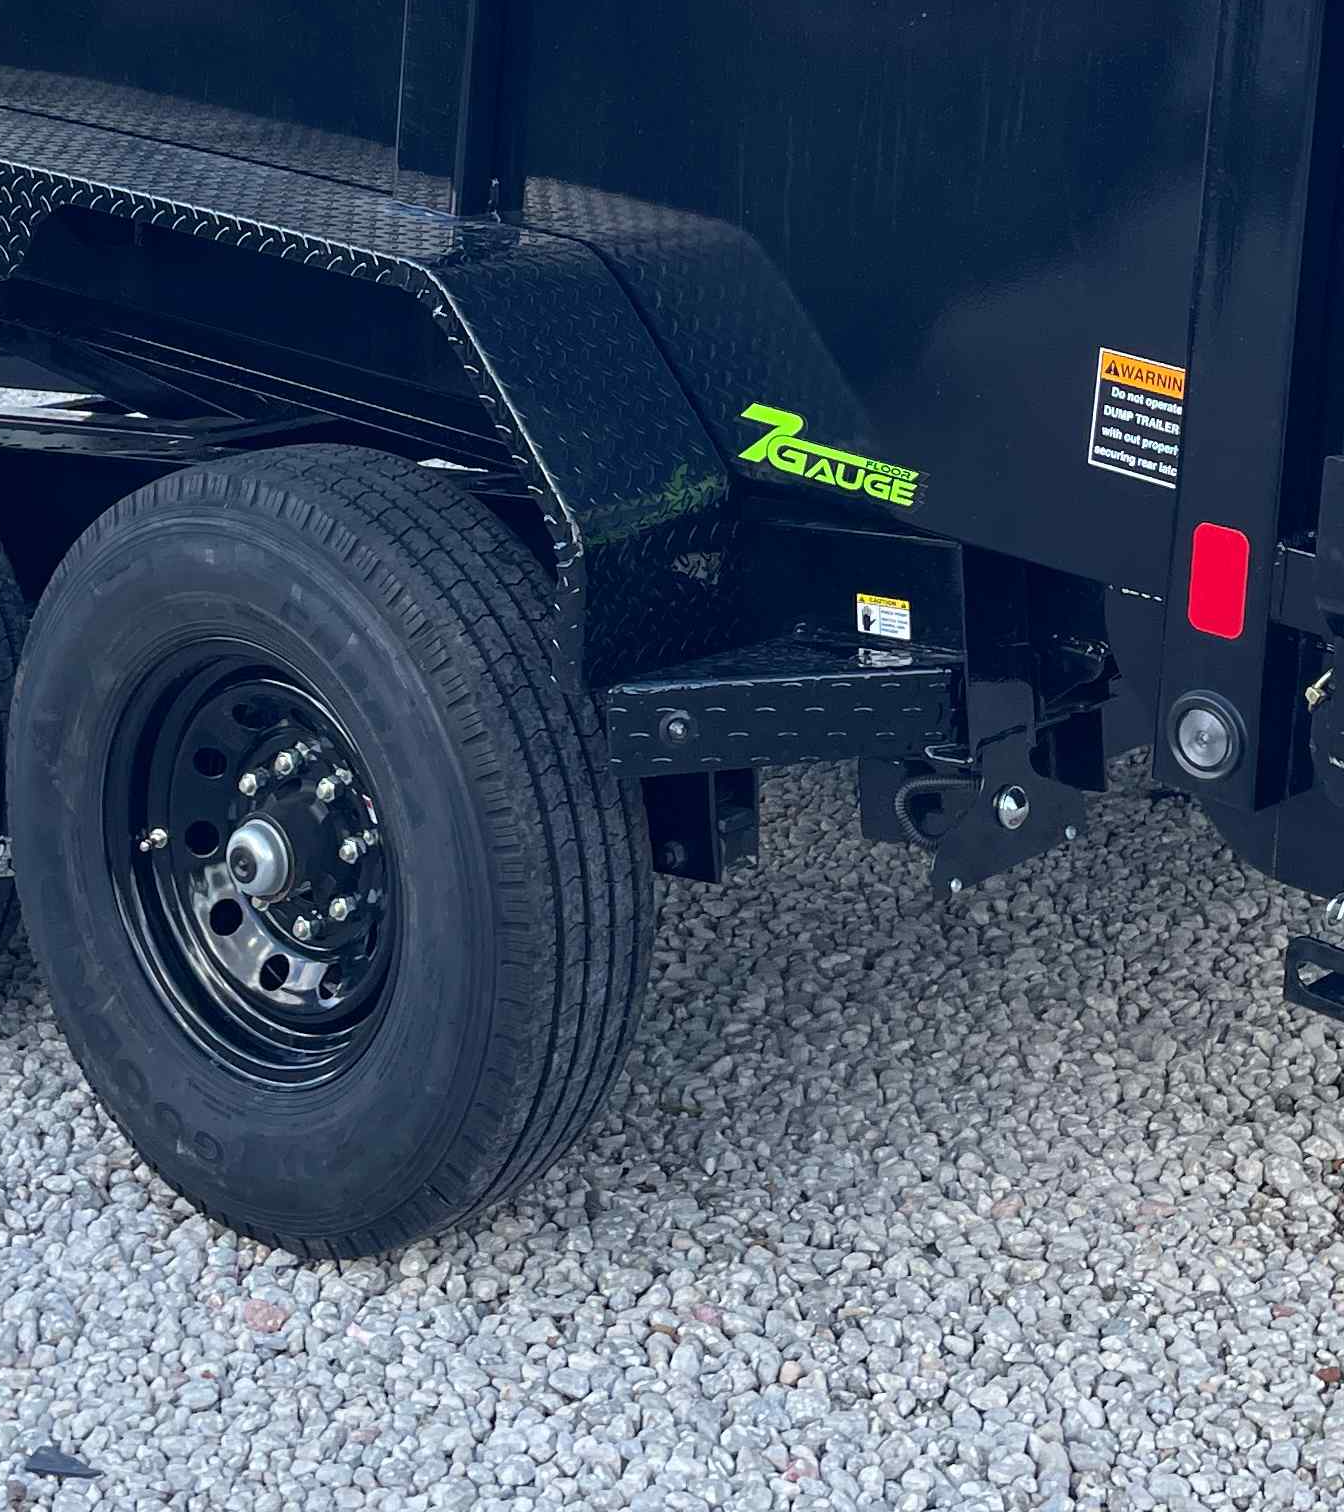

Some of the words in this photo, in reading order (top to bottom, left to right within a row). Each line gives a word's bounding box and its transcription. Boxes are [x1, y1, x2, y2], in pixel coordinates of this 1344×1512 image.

[1120, 363, 1183, 393] WARNIN
[1111, 386, 1126, 400] Do
[1127, 394, 1144, 406] not
[737, 402, 805, 463] 7
[1103, 404, 1134, 422] DUMP
[1136, 413, 1181, 436] TRAILER
[1101, 426, 1123, 441] with
[1124, 432, 1142, 446] out
[1142, 438, 1180, 459] properl
[767, 435, 918, 507] GAUGE
[865, 459, 913, 480] FLOOR
[1094, 445, 1136, 468] securing
[1137, 457, 1158, 471] rear
[1159, 462, 1177, 477] latc
